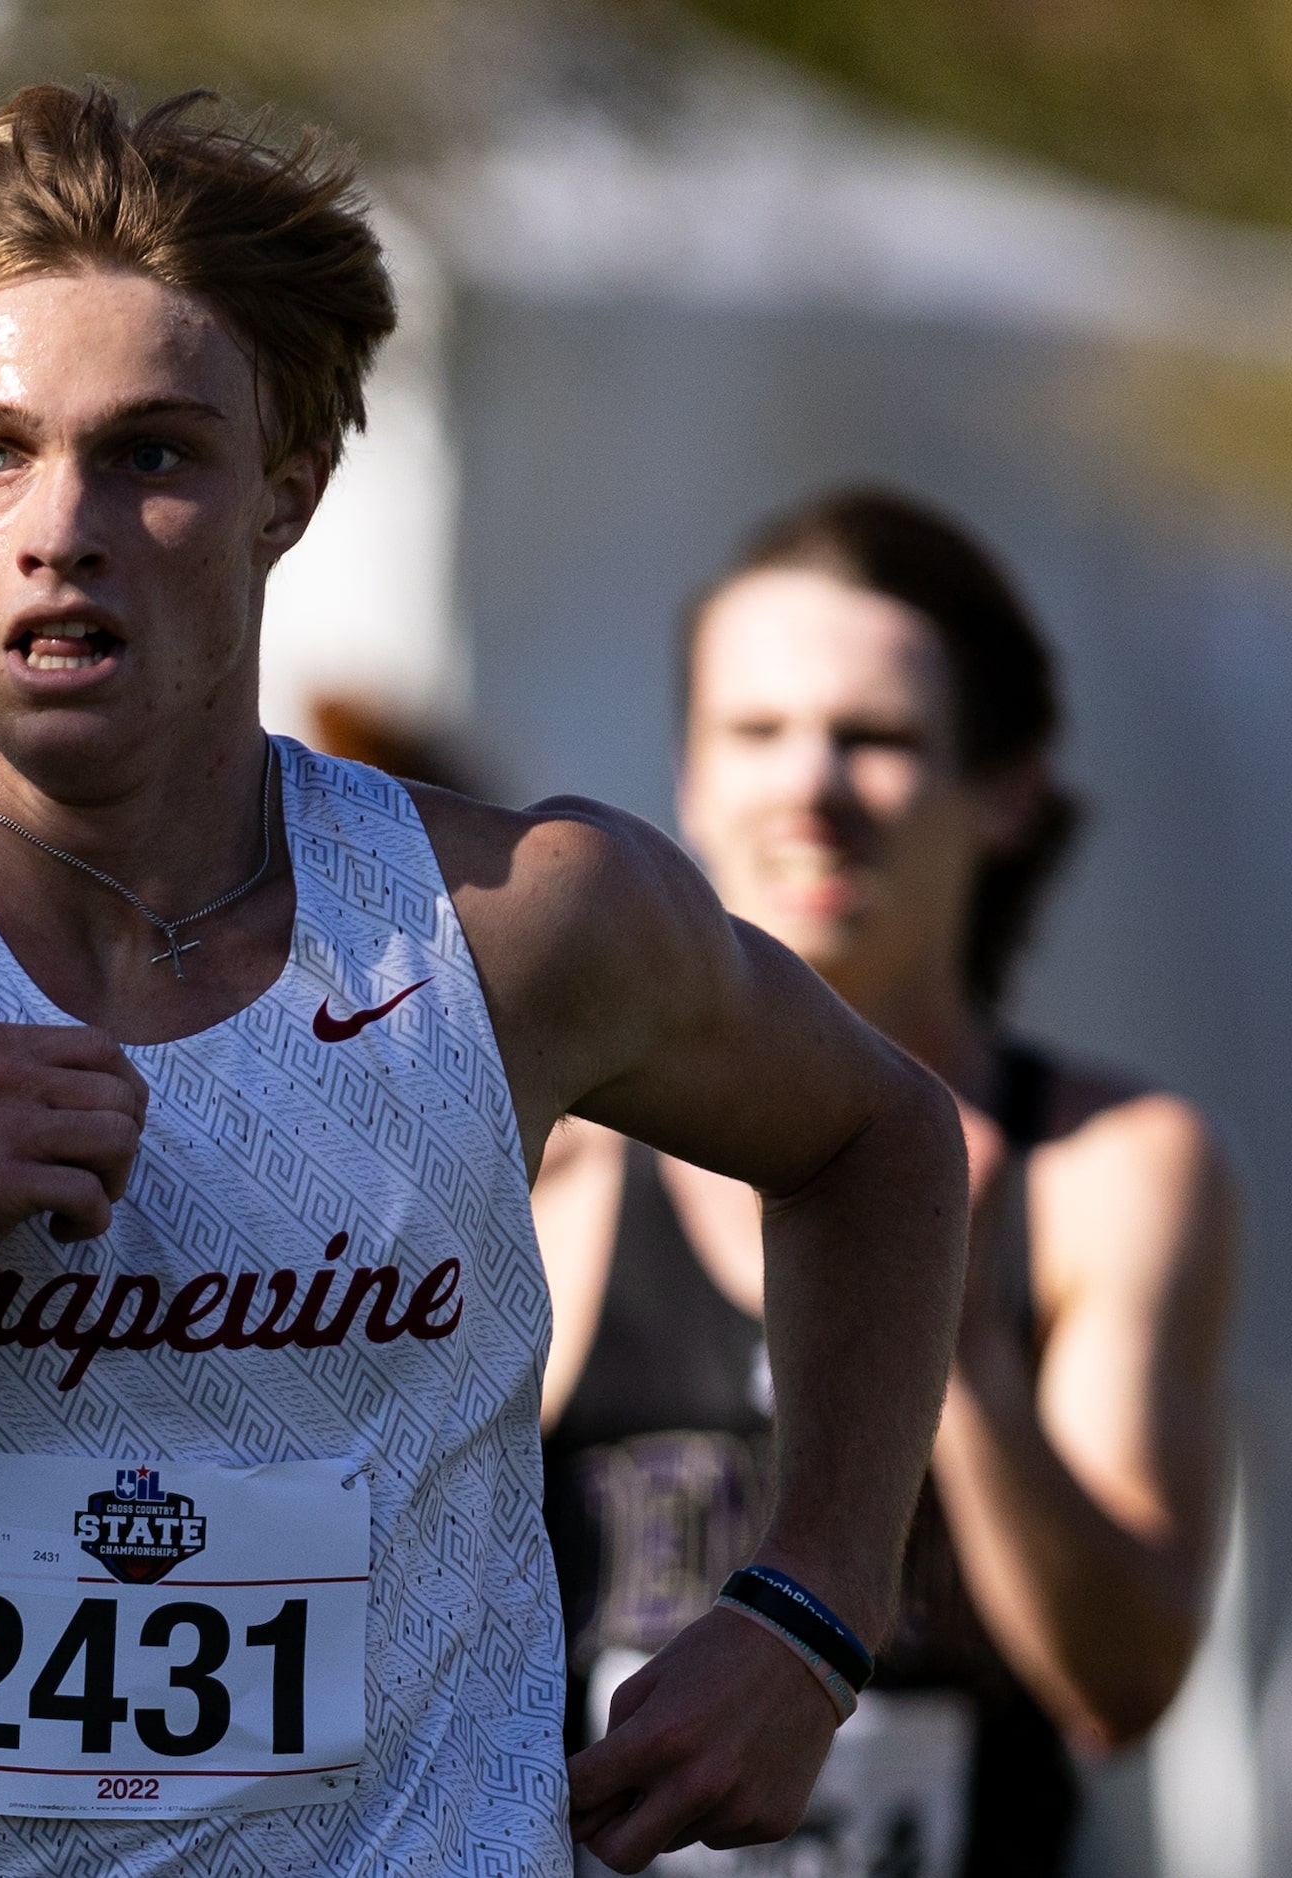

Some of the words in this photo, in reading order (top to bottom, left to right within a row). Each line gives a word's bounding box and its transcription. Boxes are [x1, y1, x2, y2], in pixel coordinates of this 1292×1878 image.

[106, 1503, 134, 1514] CROSS
[135, 1505, 176, 1516] COUNTRY
[1, 1533, 11, 1541] 11
[77, 1514, 203, 1547] STATE
[32, 1550, 60, 1563] 2431
[99, 1545, 180, 1558] CHAMPIONSHIPS
[96, 1778, 160, 1800] 2022
